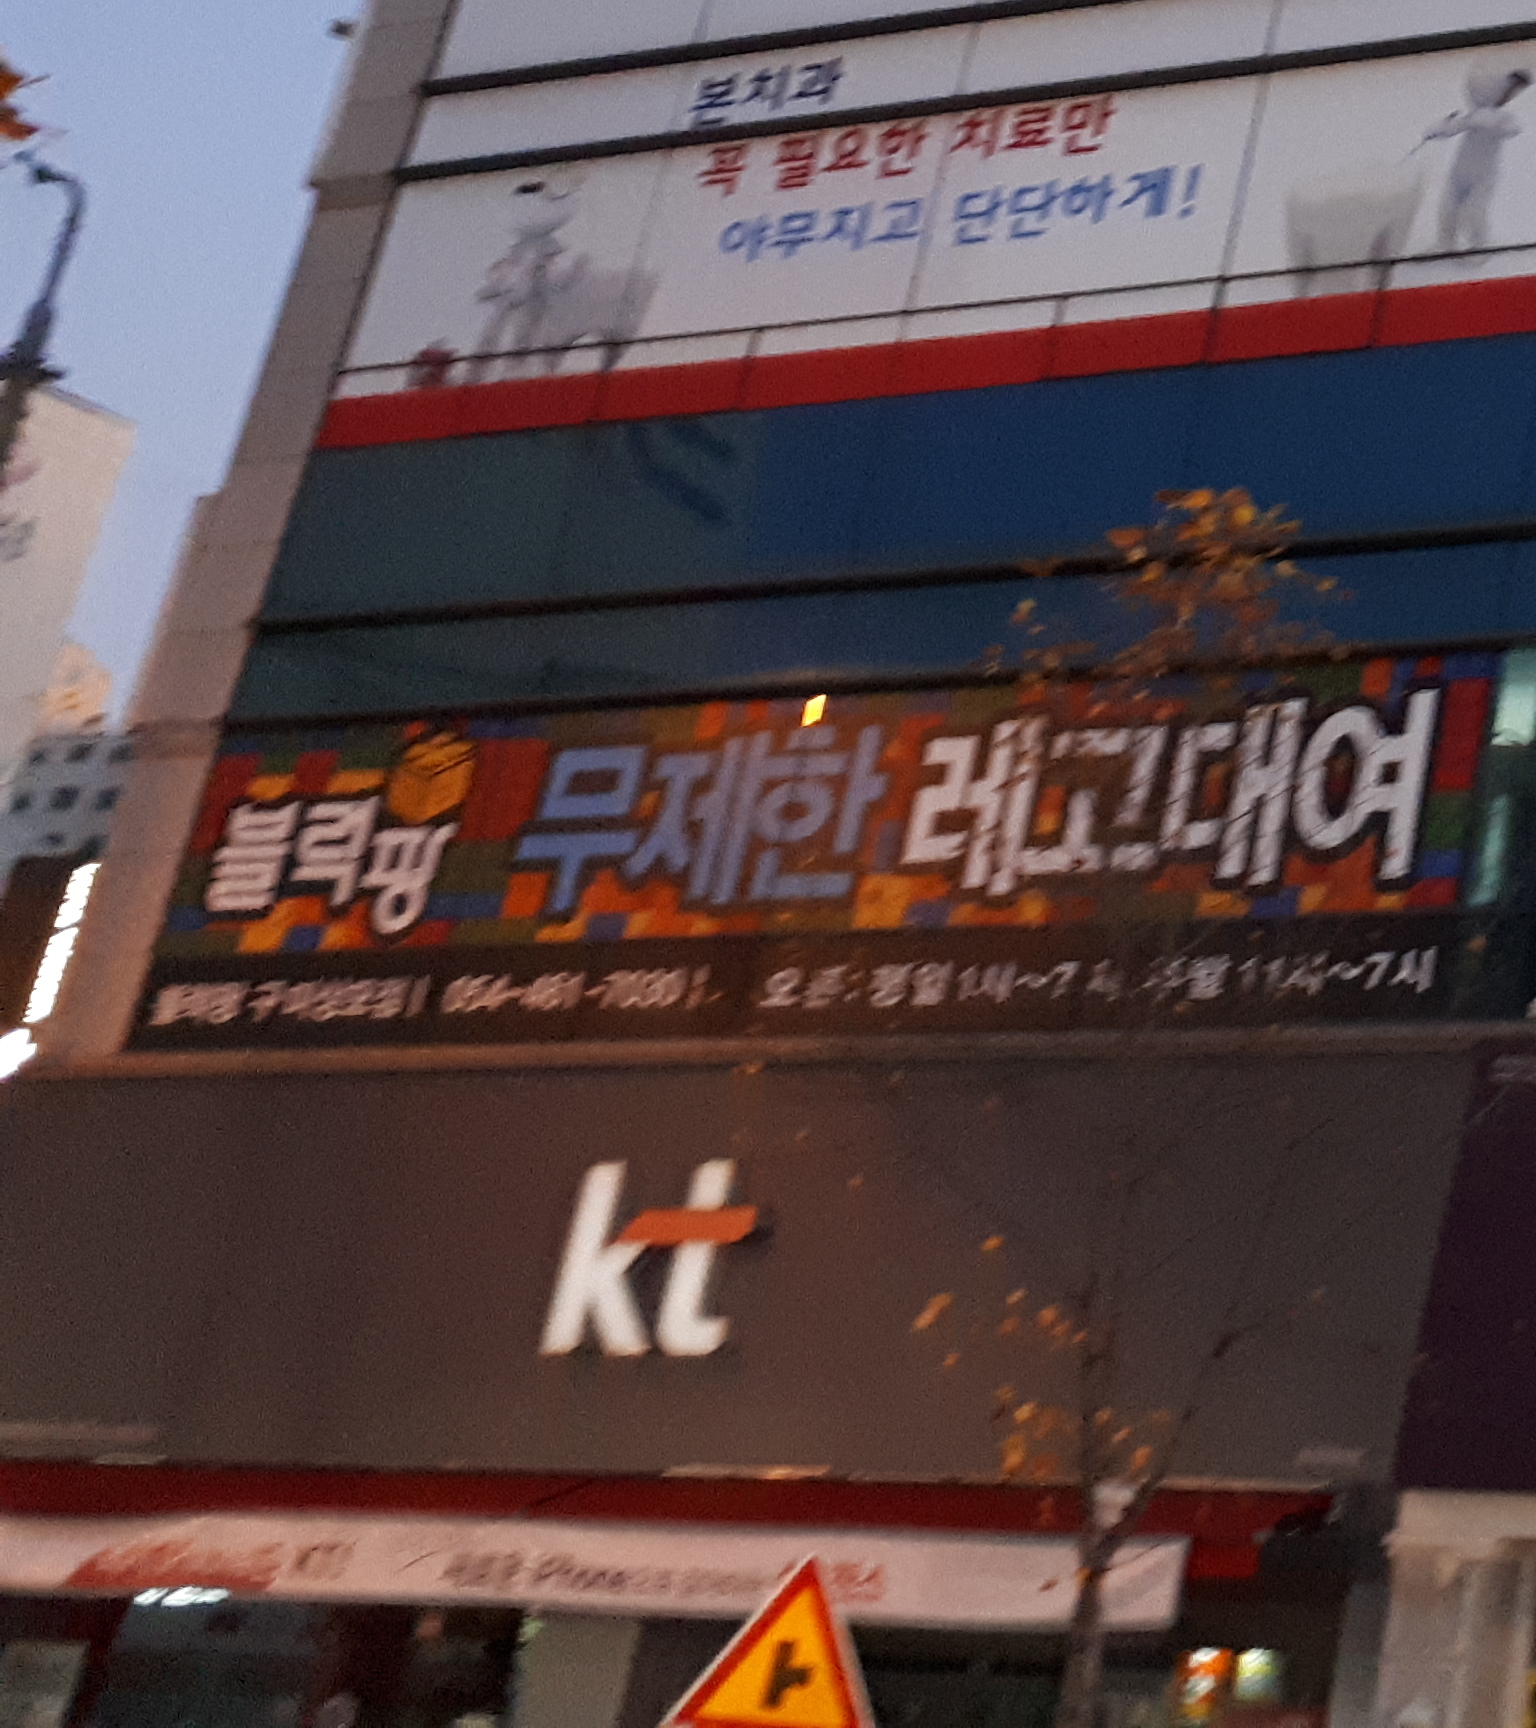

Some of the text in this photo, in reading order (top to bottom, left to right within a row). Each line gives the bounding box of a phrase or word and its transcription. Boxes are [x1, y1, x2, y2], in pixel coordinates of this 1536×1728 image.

[688, 57, 843, 130] 본치과
[697, 93, 1120, 196] 꼭 필요한 치료만
[717, 163, 1206, 264] 야무지고 단단하게!
[515, 720, 888, 912] 무제한
[900, 686, 1441, 896] 레고대여
[539, 1158, 758, 1357] kt
